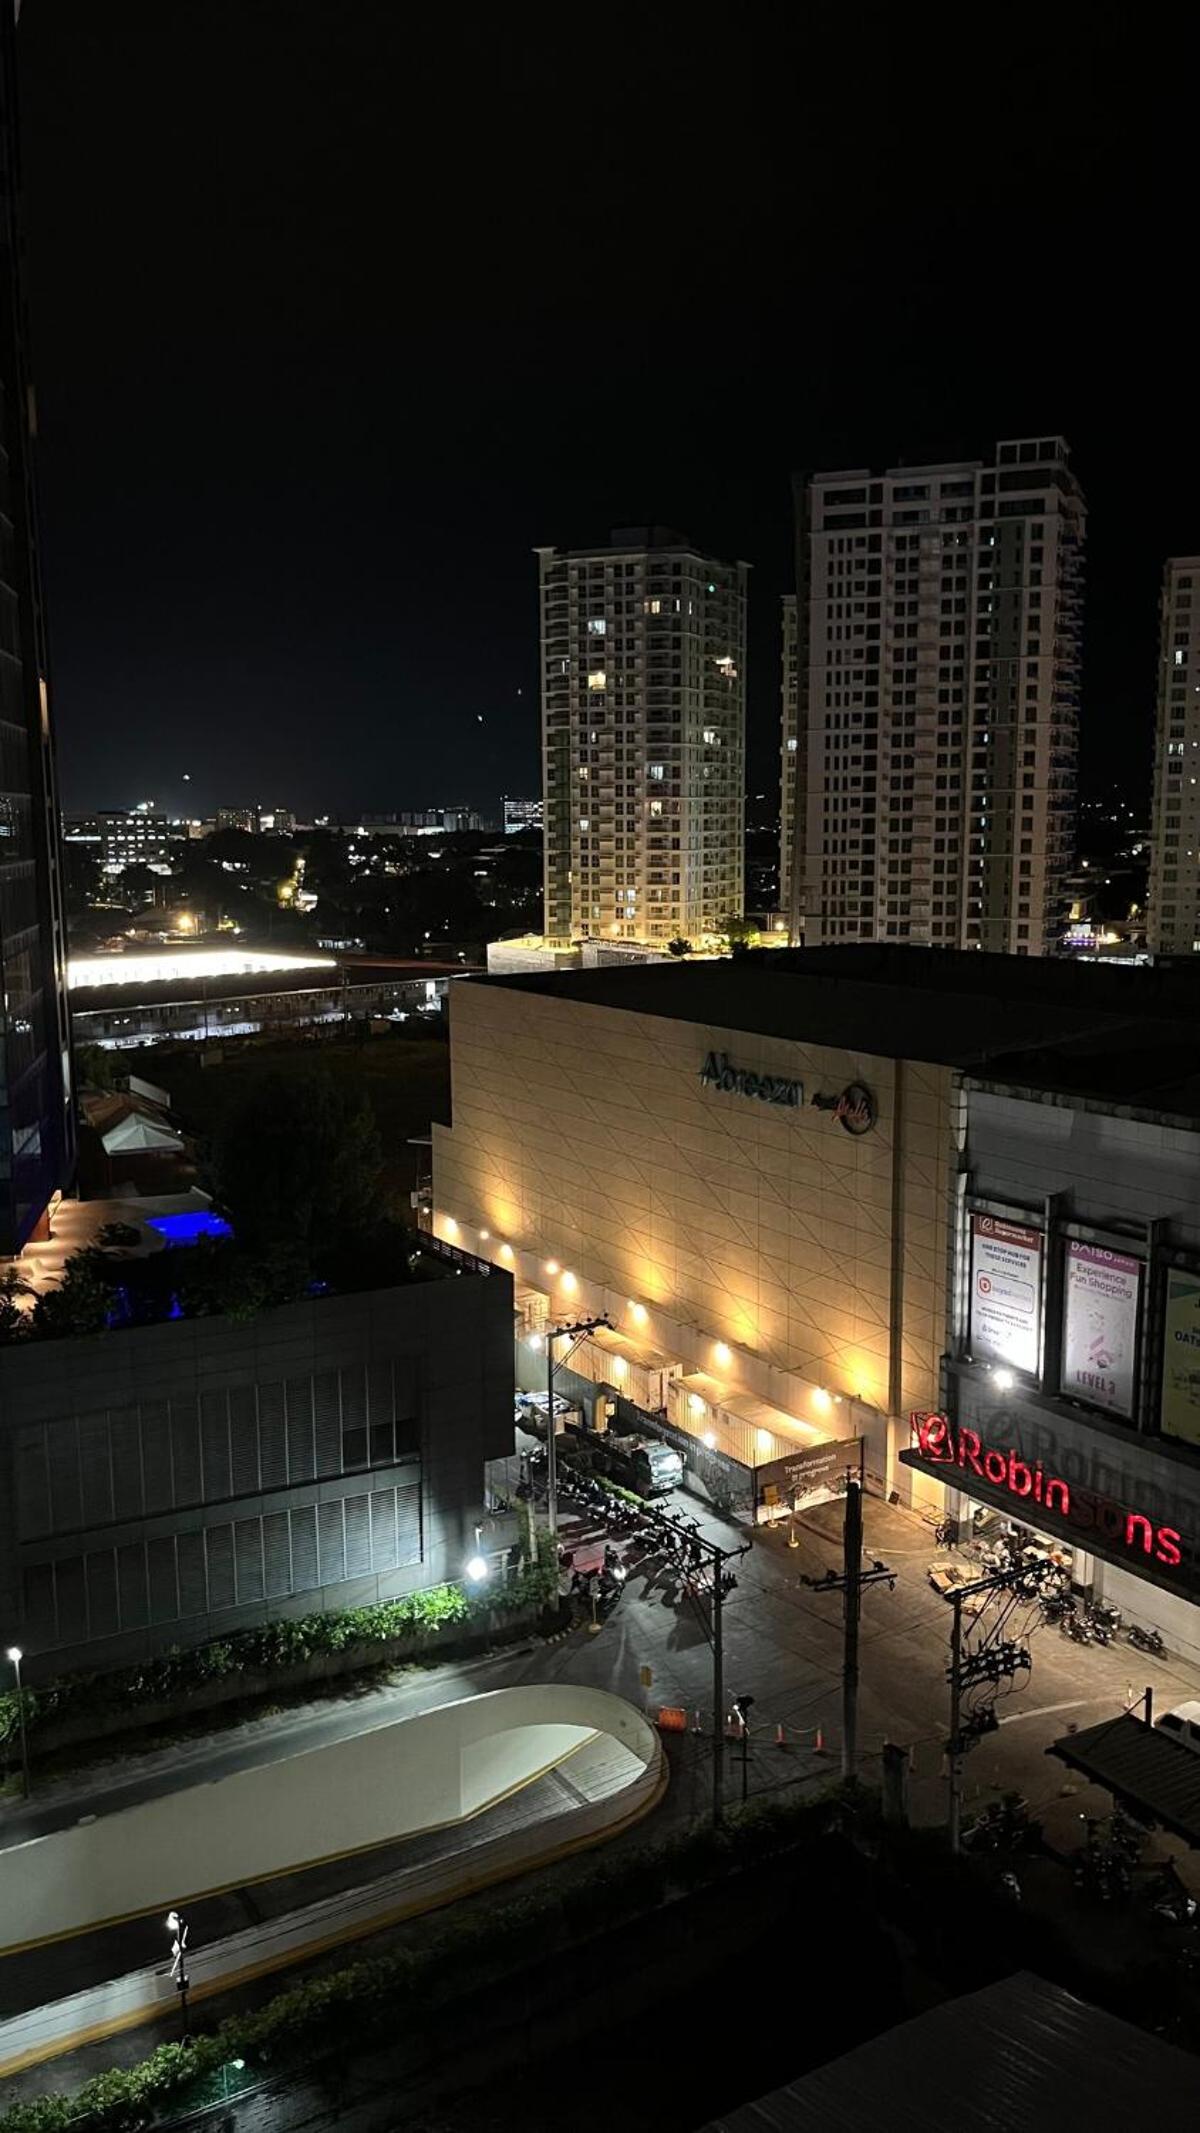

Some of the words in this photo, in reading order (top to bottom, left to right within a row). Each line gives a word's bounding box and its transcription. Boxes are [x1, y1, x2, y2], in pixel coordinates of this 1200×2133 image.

[1070, 1271, 1087, 1285] Fun
[1087, 1276, 1133, 1299] Shopping
[1076, 1262, 1127, 1285] Experience
[1076, 1370, 1107, 1393] LEVEL
[784, 1454, 837, 1475] Transformation
[957, 1427, 1183, 1567] Robinsons
